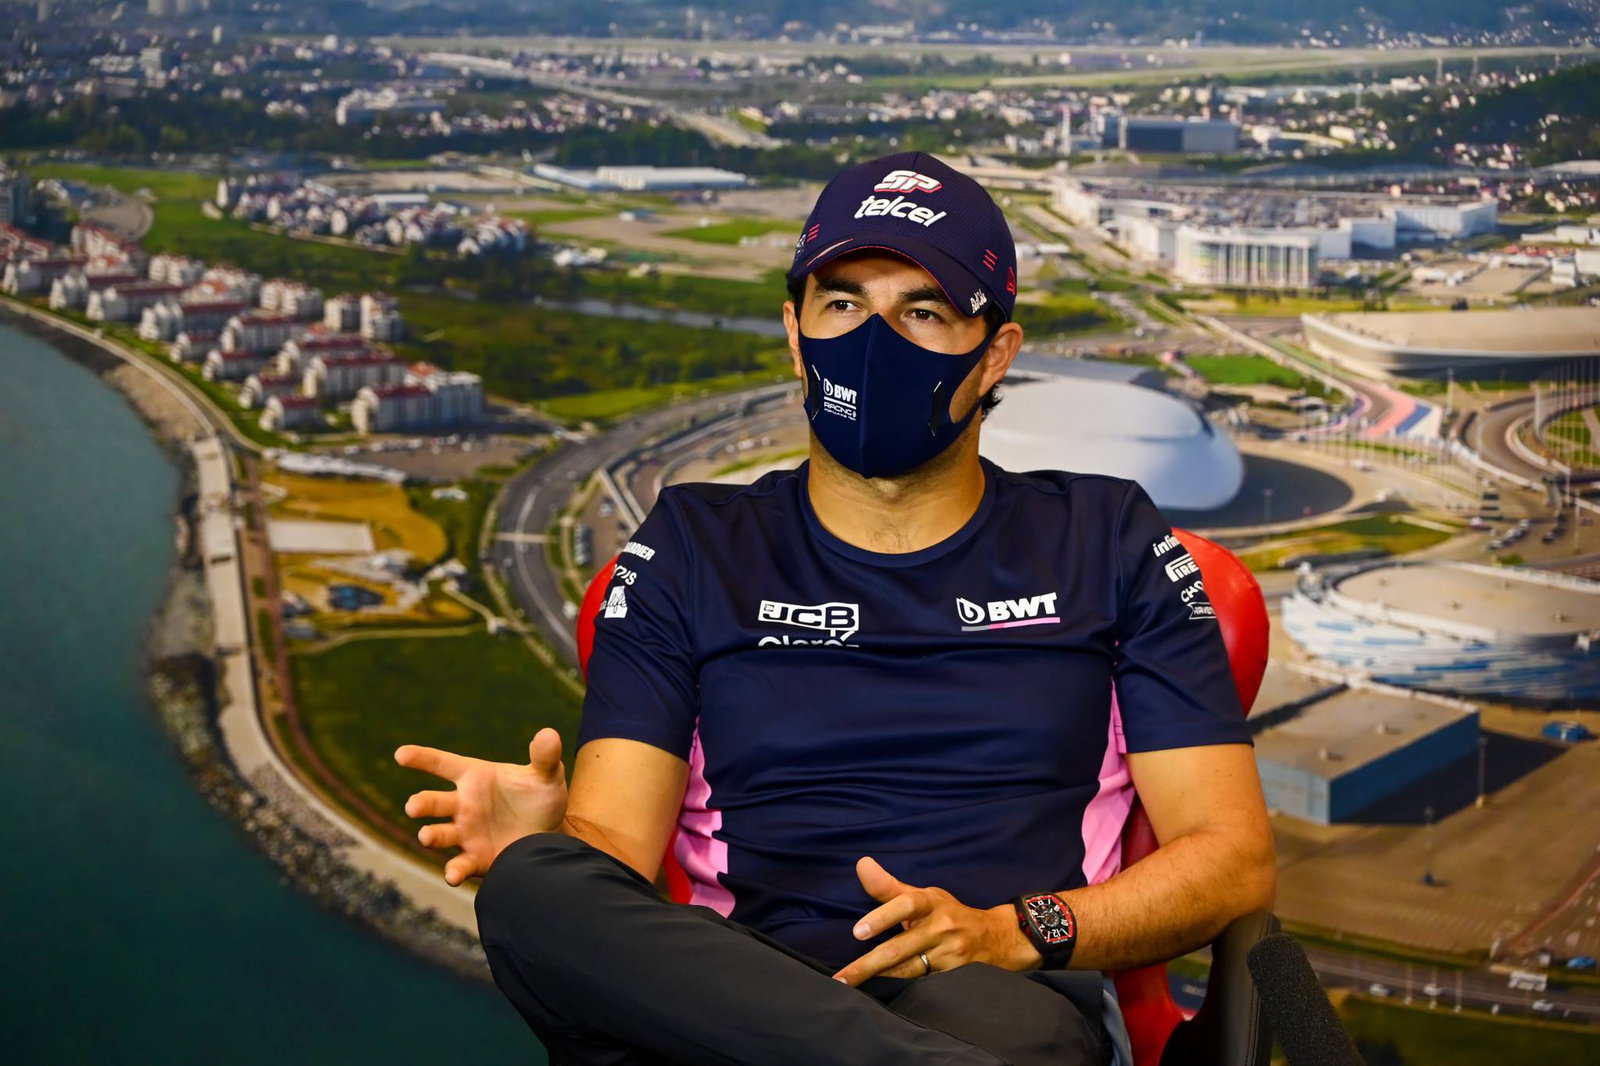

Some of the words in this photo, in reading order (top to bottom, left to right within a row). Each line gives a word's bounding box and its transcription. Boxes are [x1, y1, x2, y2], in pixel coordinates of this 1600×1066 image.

[854, 195, 947, 227] telcel
[834, 384, 857, 405] BWT
[1164, 553, 1200, 583] PIRE
[760, 602, 858, 631] JCB
[987, 592, 1058, 622] BWT
